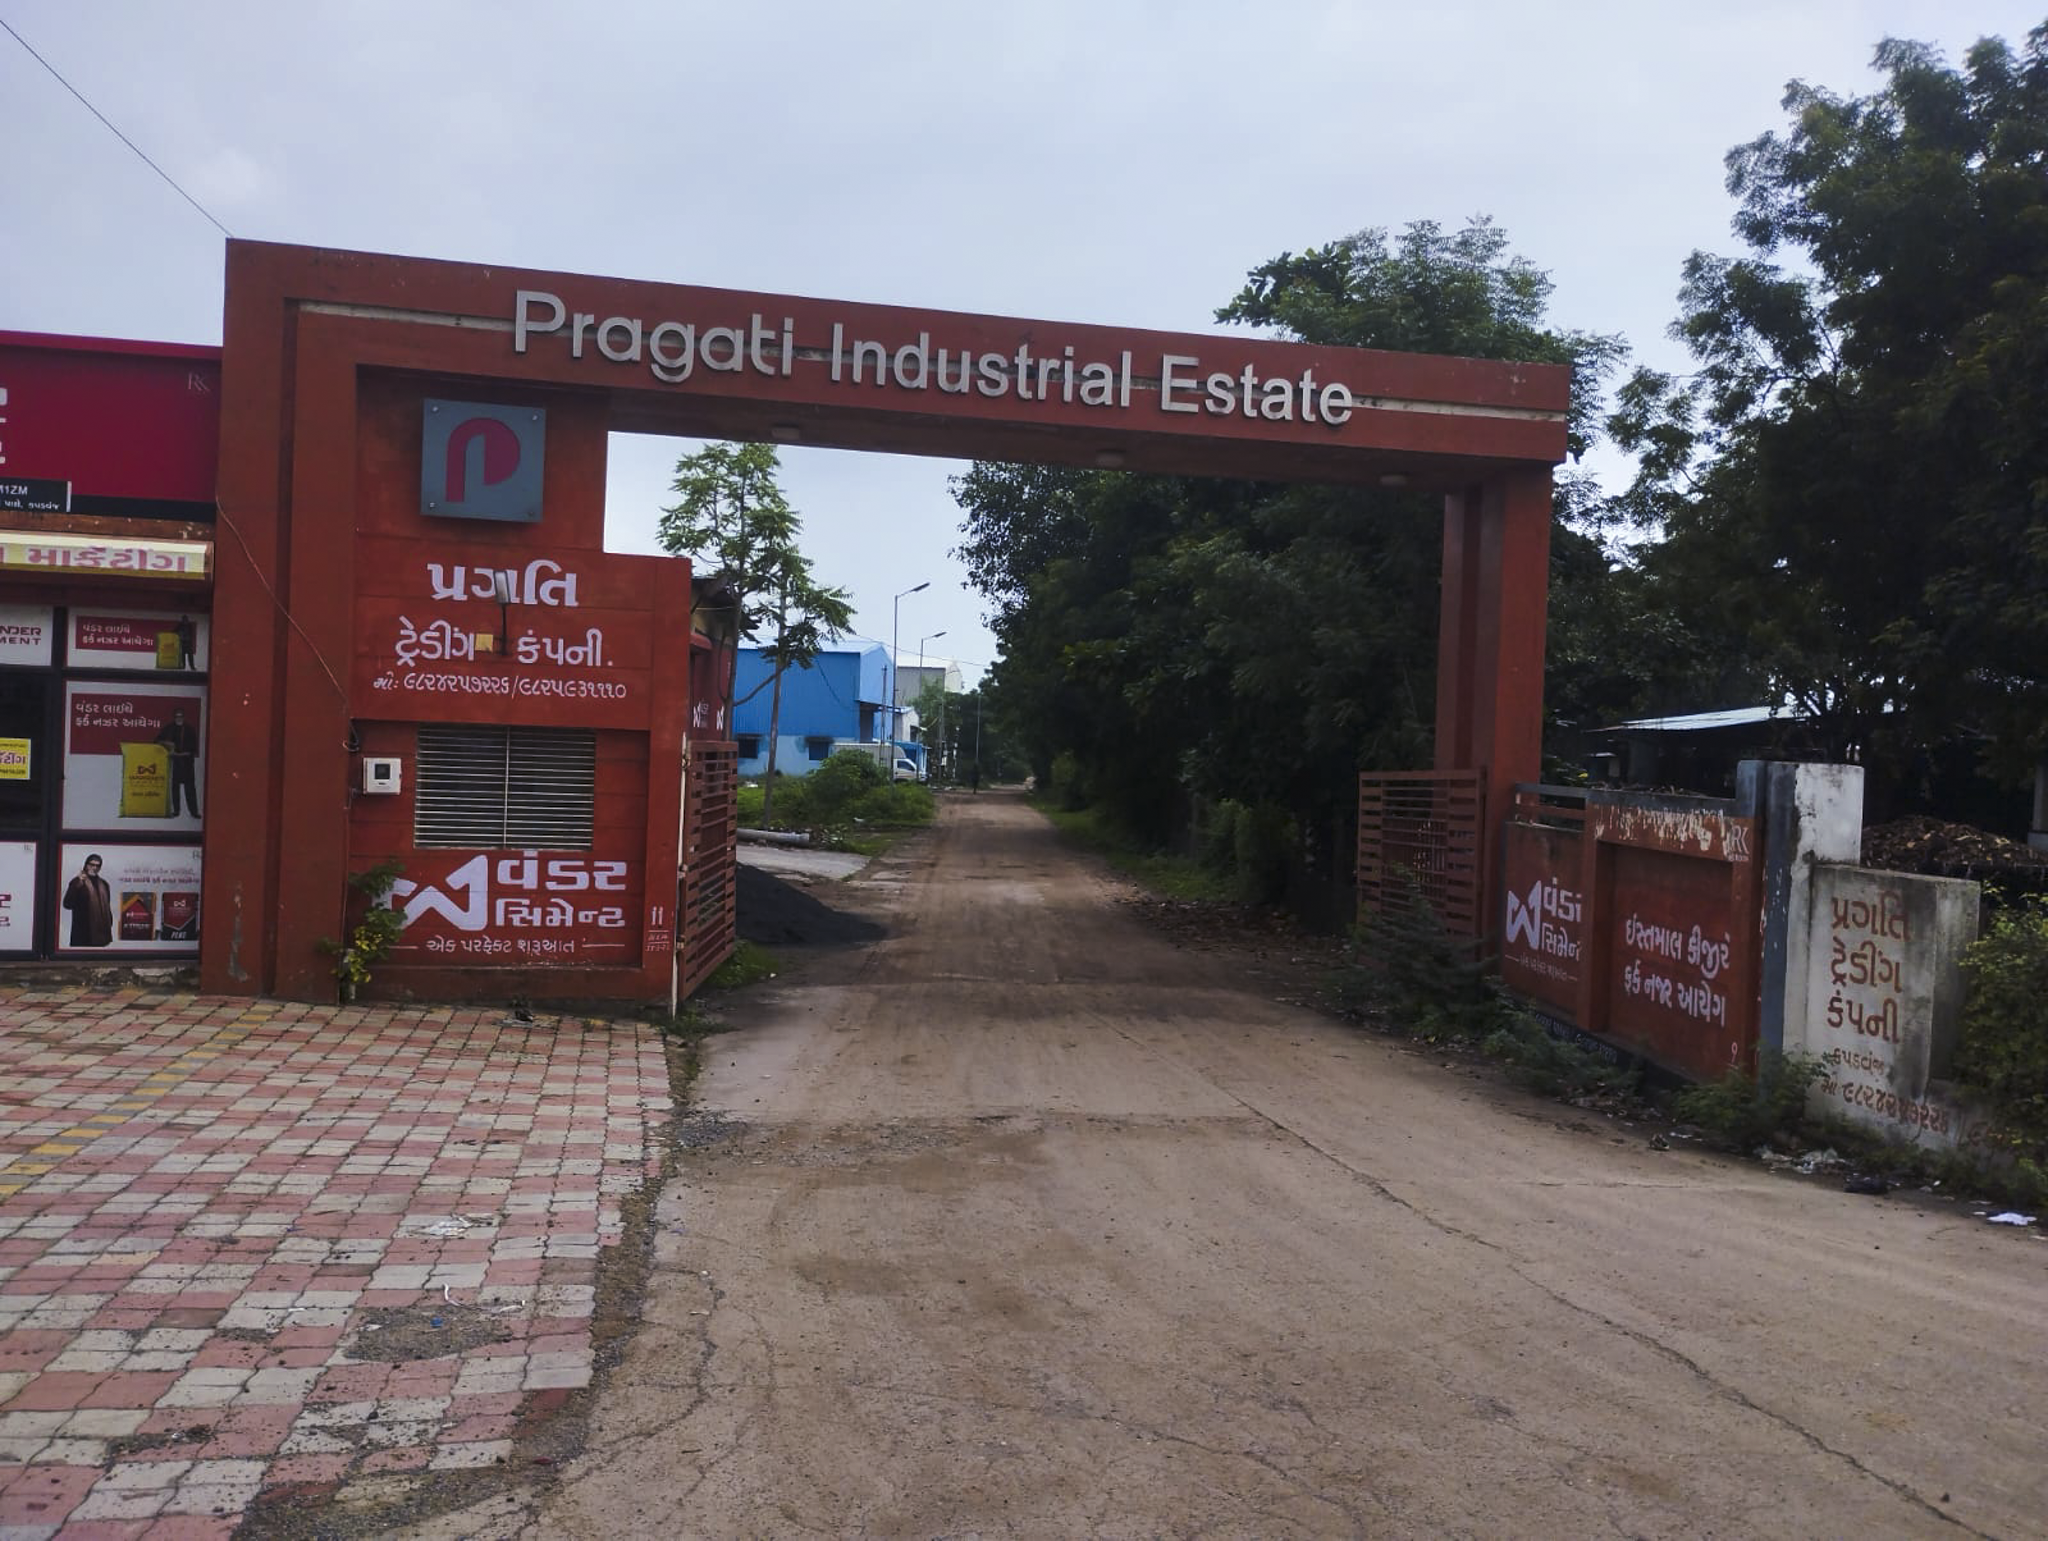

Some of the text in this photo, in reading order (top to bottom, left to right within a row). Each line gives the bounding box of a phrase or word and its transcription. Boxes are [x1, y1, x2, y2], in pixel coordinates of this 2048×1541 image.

[514, 289, 1353, 426] Pragati Industrial Estate
[427, 559, 579, 607] પ્રગતિ
[497, 850, 627, 891] વંડર
[495, 898, 626, 928] સિમેન્ટ
[1827, 990, 1900, 1044] કંપની
